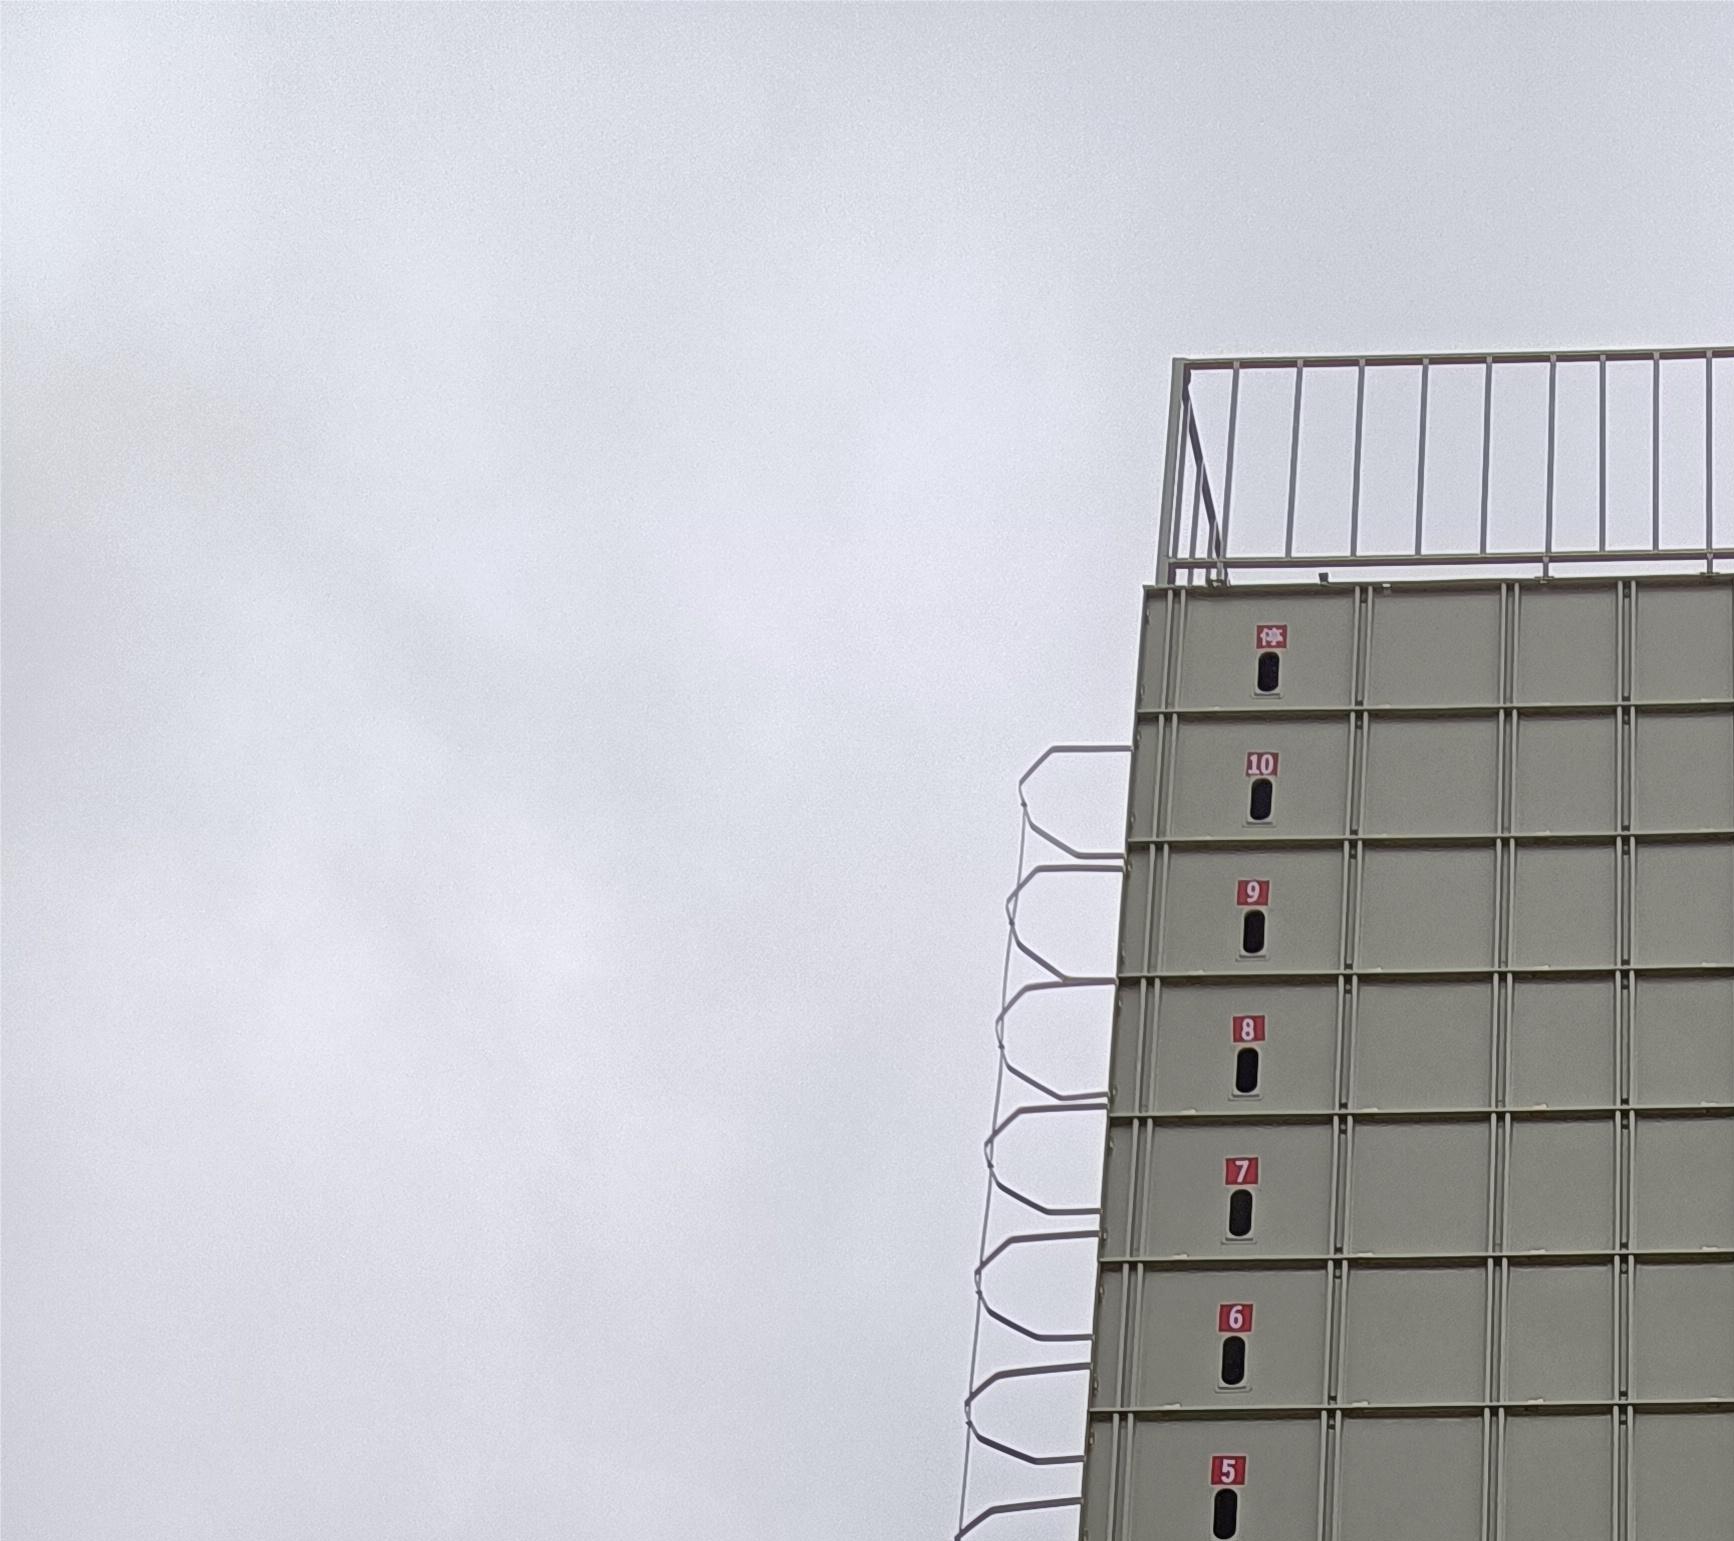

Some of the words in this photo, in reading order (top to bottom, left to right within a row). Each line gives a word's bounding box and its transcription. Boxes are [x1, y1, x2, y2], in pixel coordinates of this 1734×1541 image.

[1248, 754, 1275, 776] 10
[1246, 882, 1260, 904] 9
[1240, 1017, 1255, 1039] 8
[1235, 1159, 1250, 1183] 7
[1229, 1306, 1244, 1330] 6
[1221, 1457, 1237, 1483] 5
